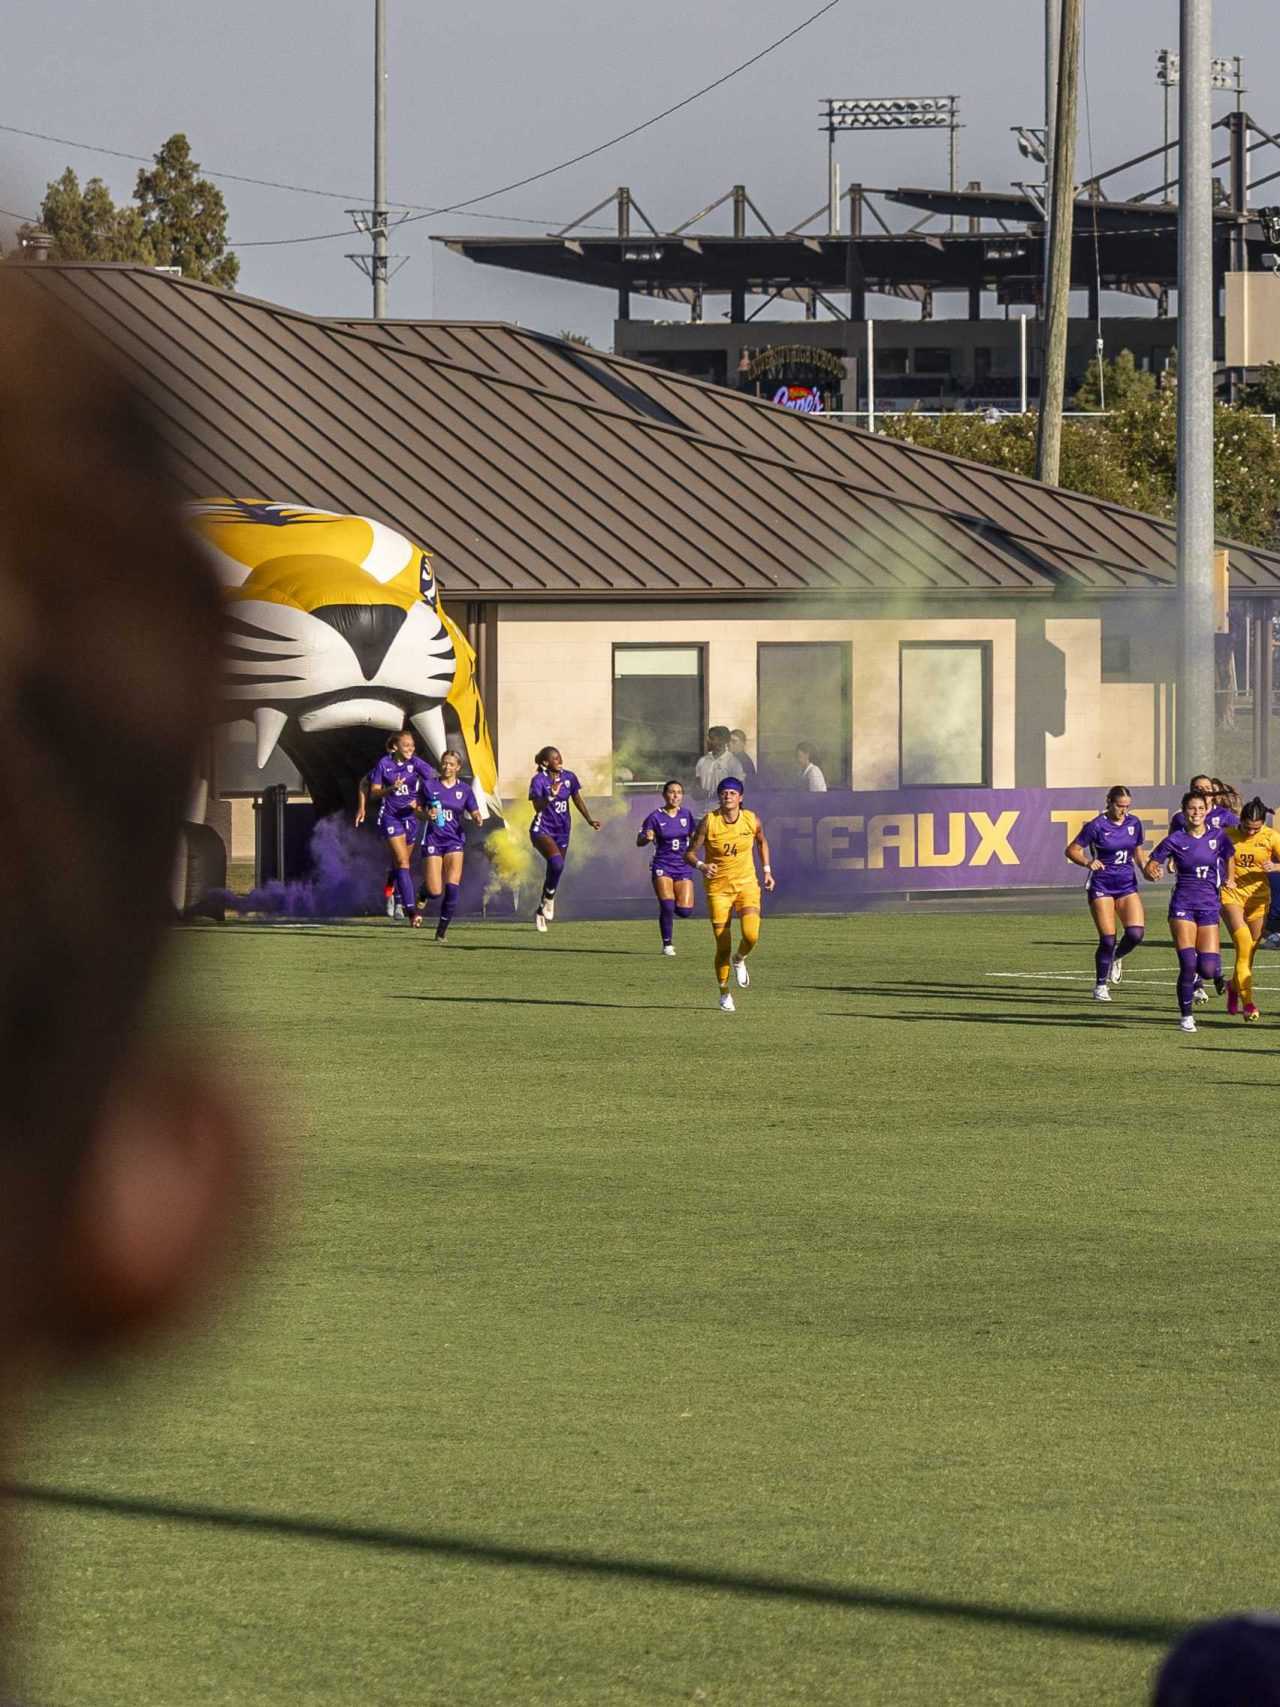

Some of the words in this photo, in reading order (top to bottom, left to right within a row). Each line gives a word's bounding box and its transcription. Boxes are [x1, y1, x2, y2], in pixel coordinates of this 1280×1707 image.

[554, 800, 567, 814] 28
[671, 839, 680, 851] 9
[766, 811, 1020, 870] GEAUX
[723, 843, 737, 857] 24
[1115, 850, 1128, 865] 21
[1195, 865, 1209, 879] 17
